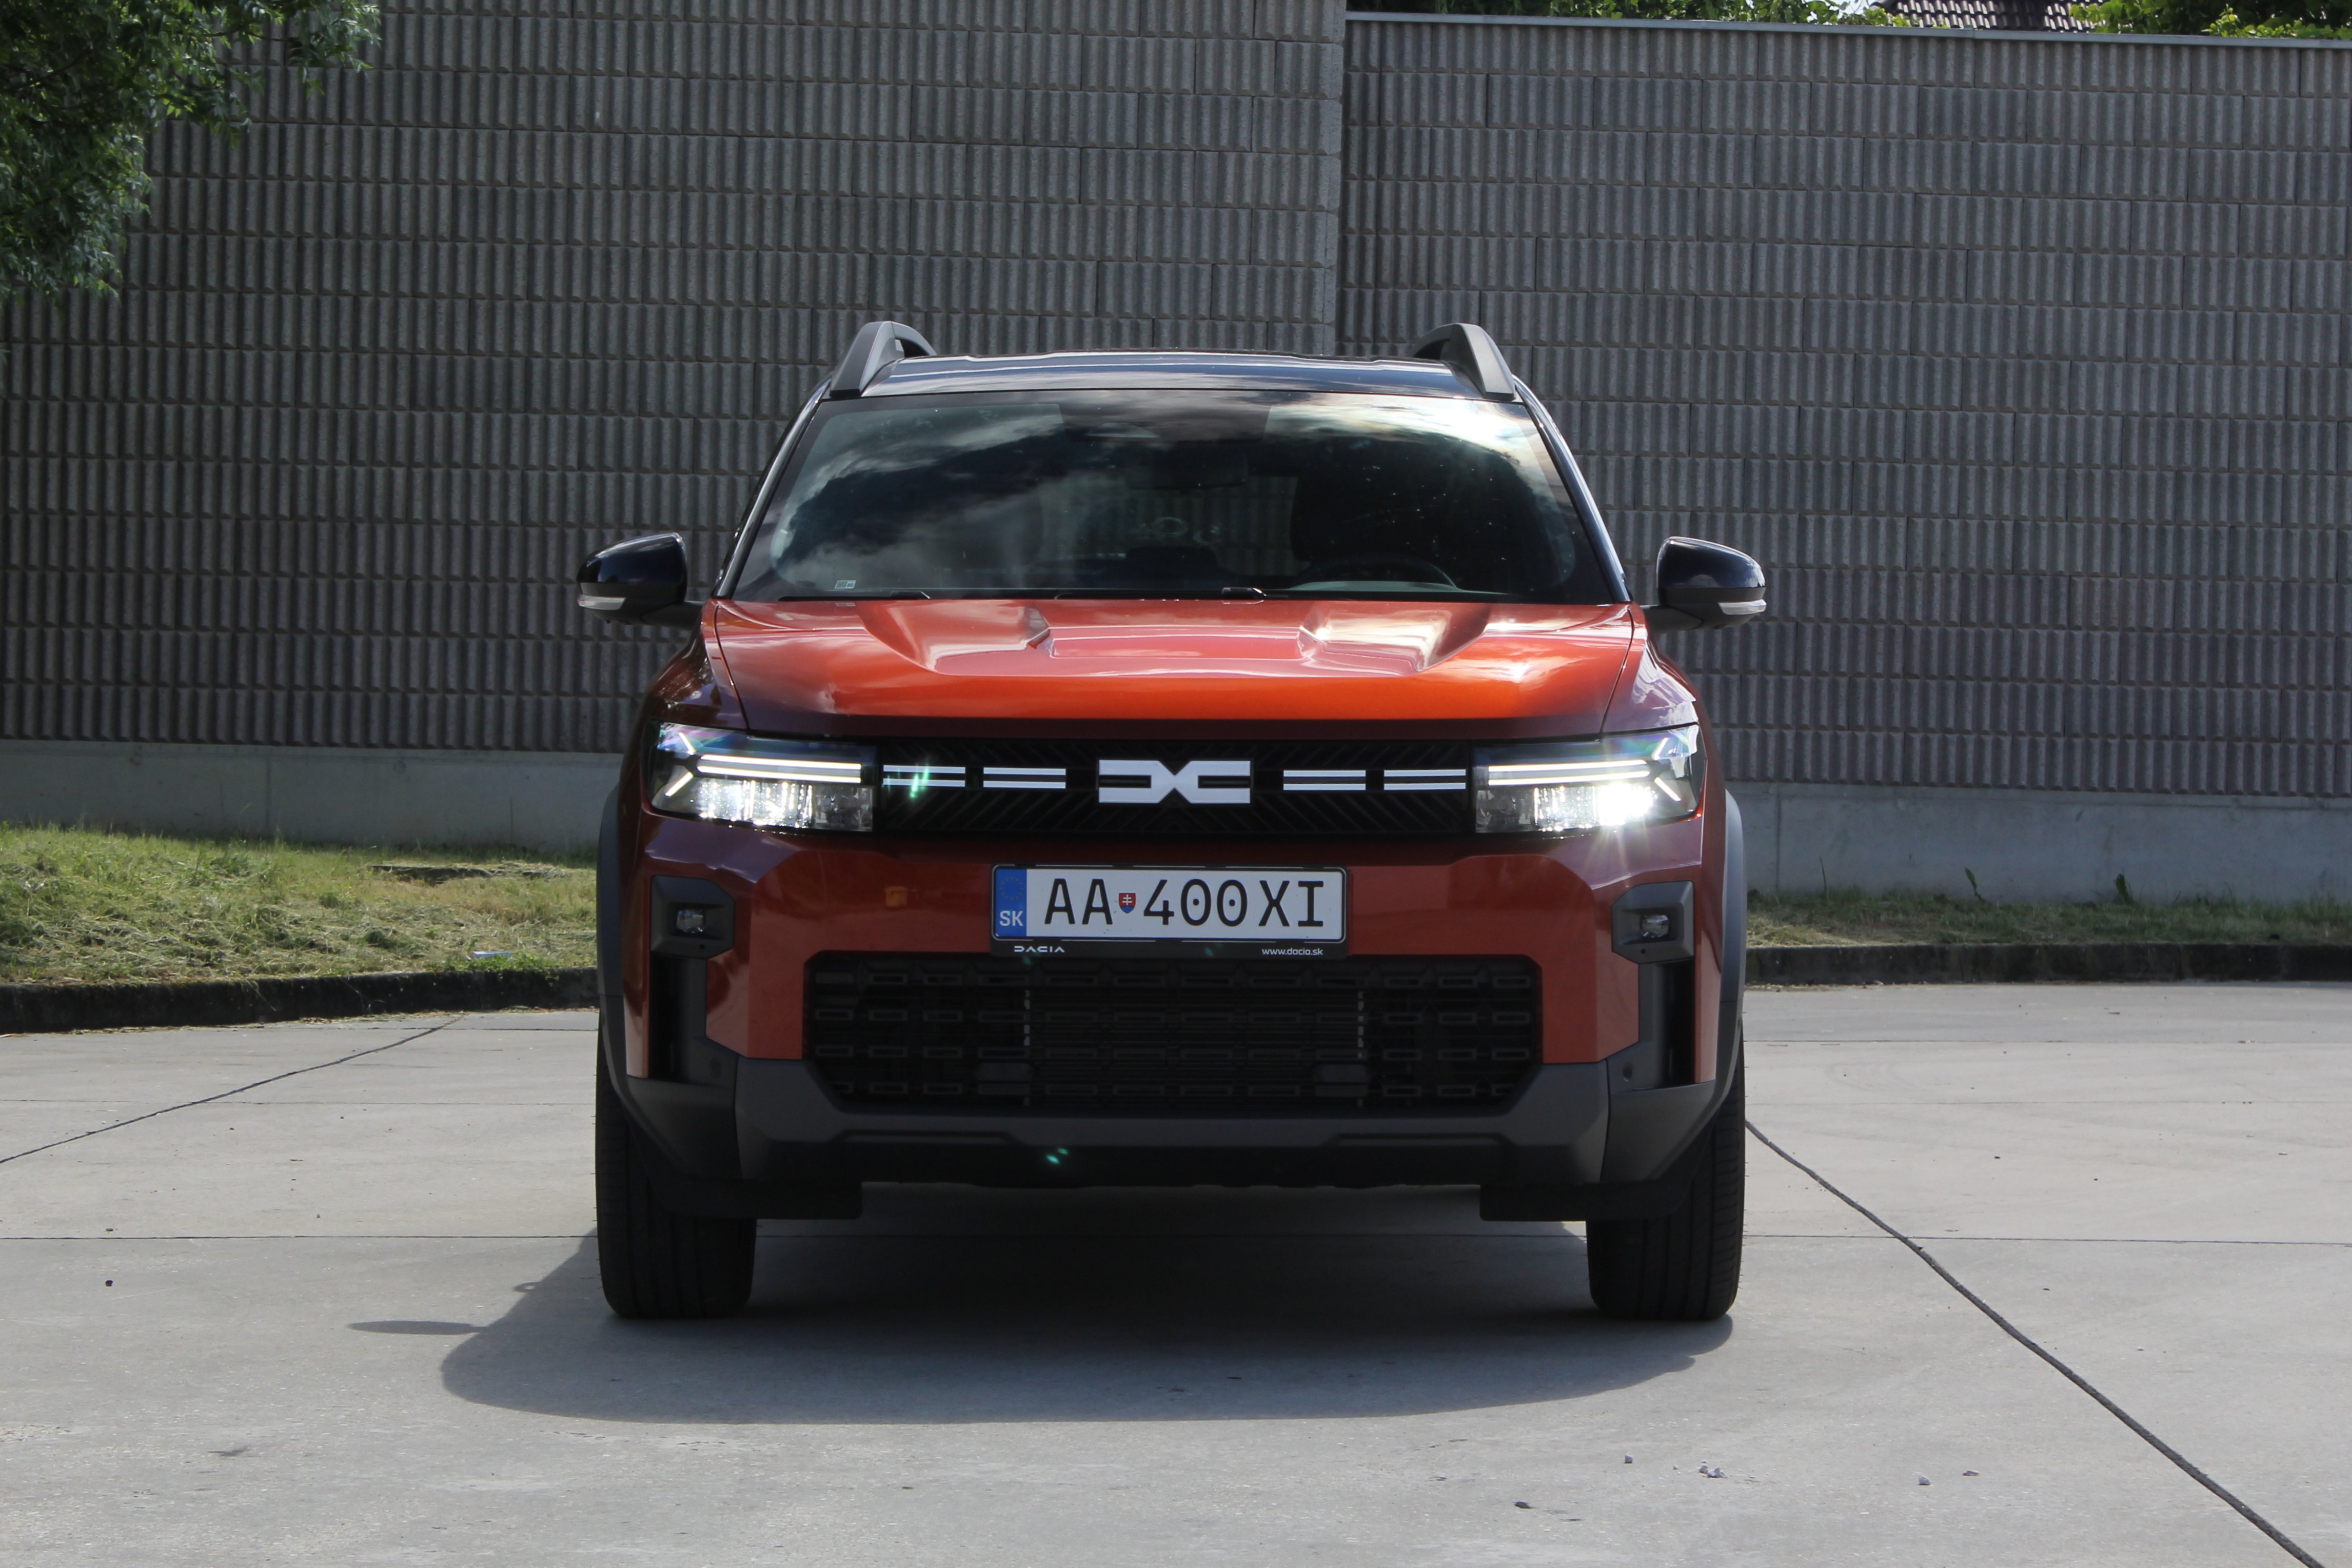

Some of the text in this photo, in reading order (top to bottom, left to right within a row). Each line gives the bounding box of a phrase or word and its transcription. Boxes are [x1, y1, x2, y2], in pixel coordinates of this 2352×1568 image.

[1044, 878, 1324, 927] AA 400XI
[999, 910, 1023, 926] SK
[1261, 947, 1323, 956] www.dacia.sk
